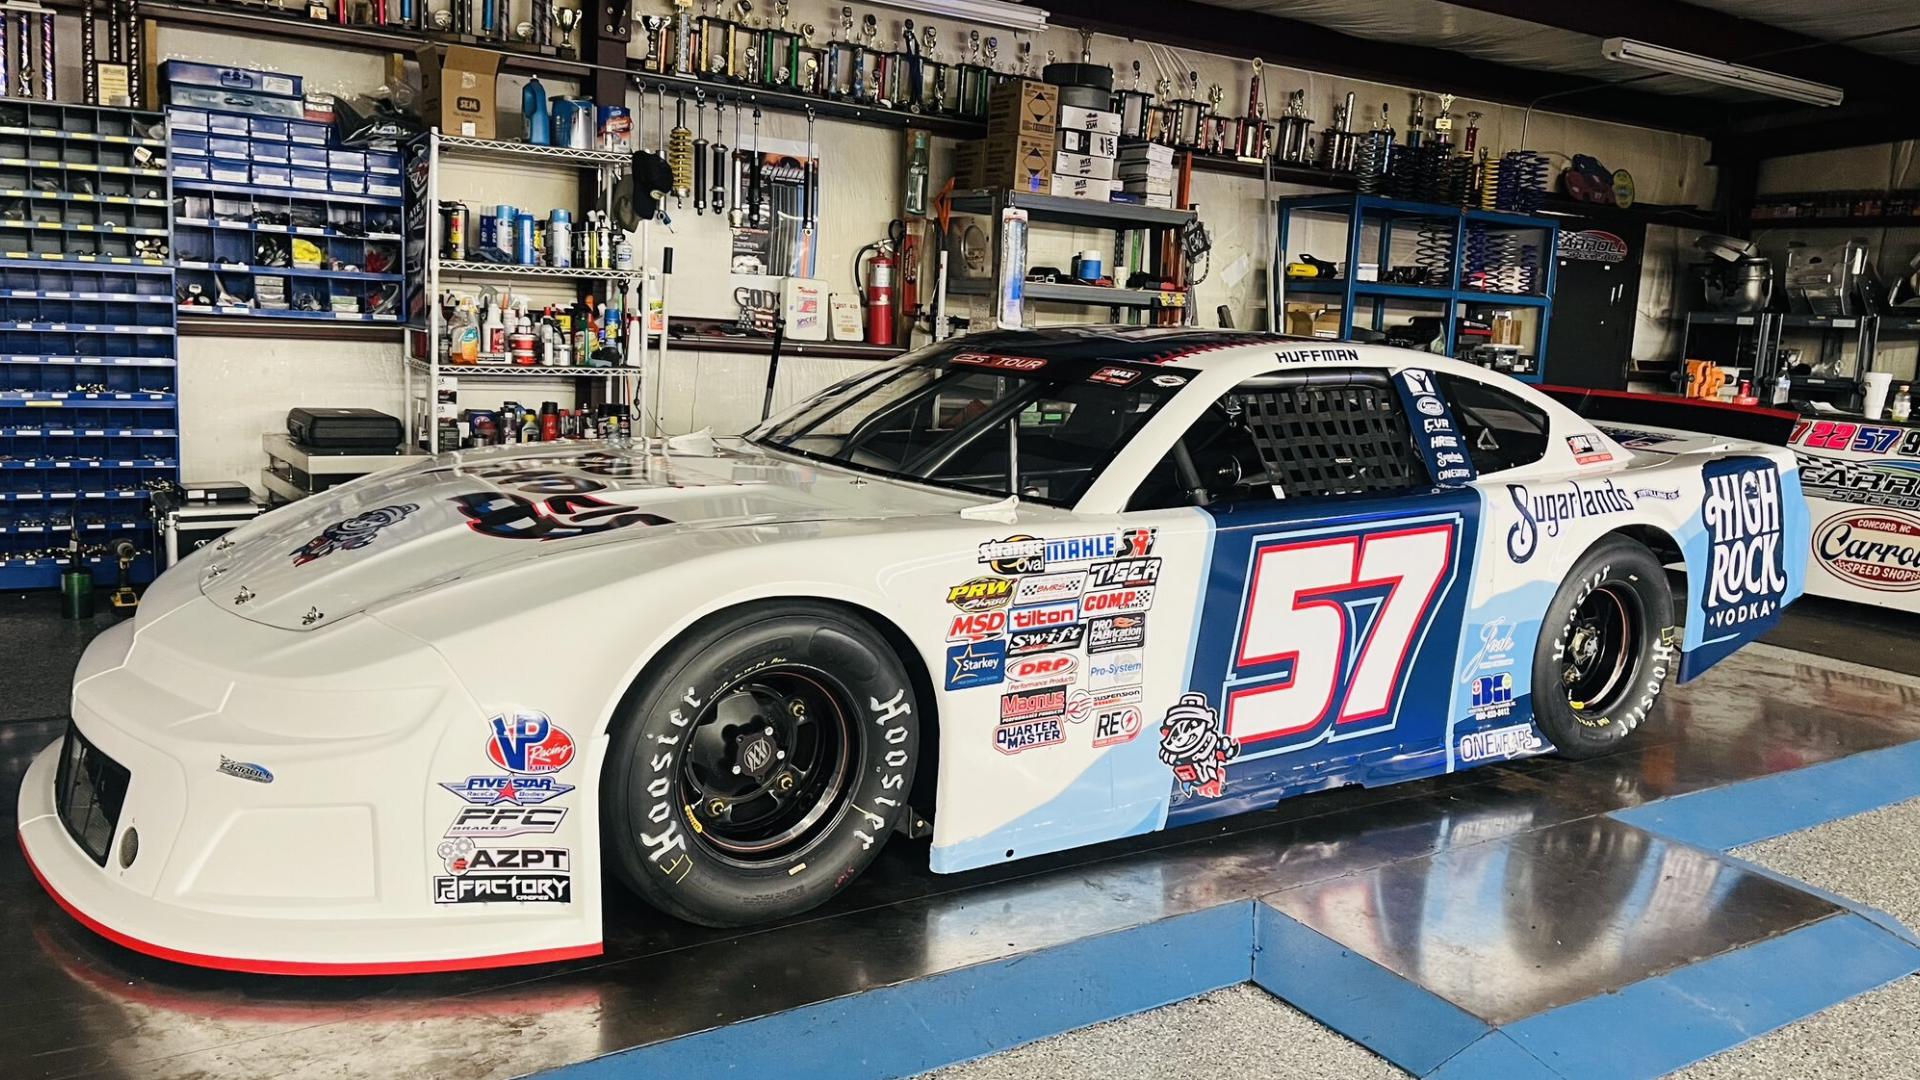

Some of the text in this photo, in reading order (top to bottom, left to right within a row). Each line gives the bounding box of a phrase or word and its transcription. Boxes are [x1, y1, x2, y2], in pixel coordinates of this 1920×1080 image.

[995, 357, 1043, 369] TOUR
[1275, 349, 1359, 363] HUFFMAN
[1805, 421, 1857, 450] 22
[1852, 425, 1904, 454] 57
[1705, 468, 1780, 543] HIGH
[1506, 478, 1634, 563] Sugarlands
[1857, 519, 1912, 533] CONCORD, NC
[1046, 535, 1115, 562] MAHLE
[1016, 557, 1044, 572] Oval
[1090, 559, 1162, 586] TIGER
[1708, 533, 1785, 608] ROCK
[1846, 562, 1912, 581] SPEED SHOP
[948, 579, 1011, 601] PRW
[1036, 583, 1066, 593] BMRS
[1084, 591, 1136, 611] COMP
[950, 612, 1006, 637] MSD
[1014, 609, 1074, 628] tilton
[1716, 602, 1770, 628] VODKA
[1092, 619, 1113, 632] PRO
[1225, 525, 1454, 745] 57
[962, 656, 999, 672] Starkey
[1019, 657, 1070, 676] DRP
[1090, 662, 1142, 677] Pro-System
[1010, 678, 1048, 690] Performance
[1049, 675, 1075, 686] Products
[1616, 637, 1674, 738] Hoosier
[1002, 691, 1065, 715] Magnus
[493, 713, 550, 771] VP
[996, 721, 1058, 743] QUARTER
[1007, 730, 1060, 749] MASTER
[529, 744, 573, 764] Racing
[641, 686, 705, 863] Hoosier
[853, 688, 912, 851] Hoosier
[467, 778, 552, 790] FIVE STAR
[456, 808, 563, 826] PFC
[469, 849, 567, 868] AZPT
[459, 875, 569, 900] FACTORY
